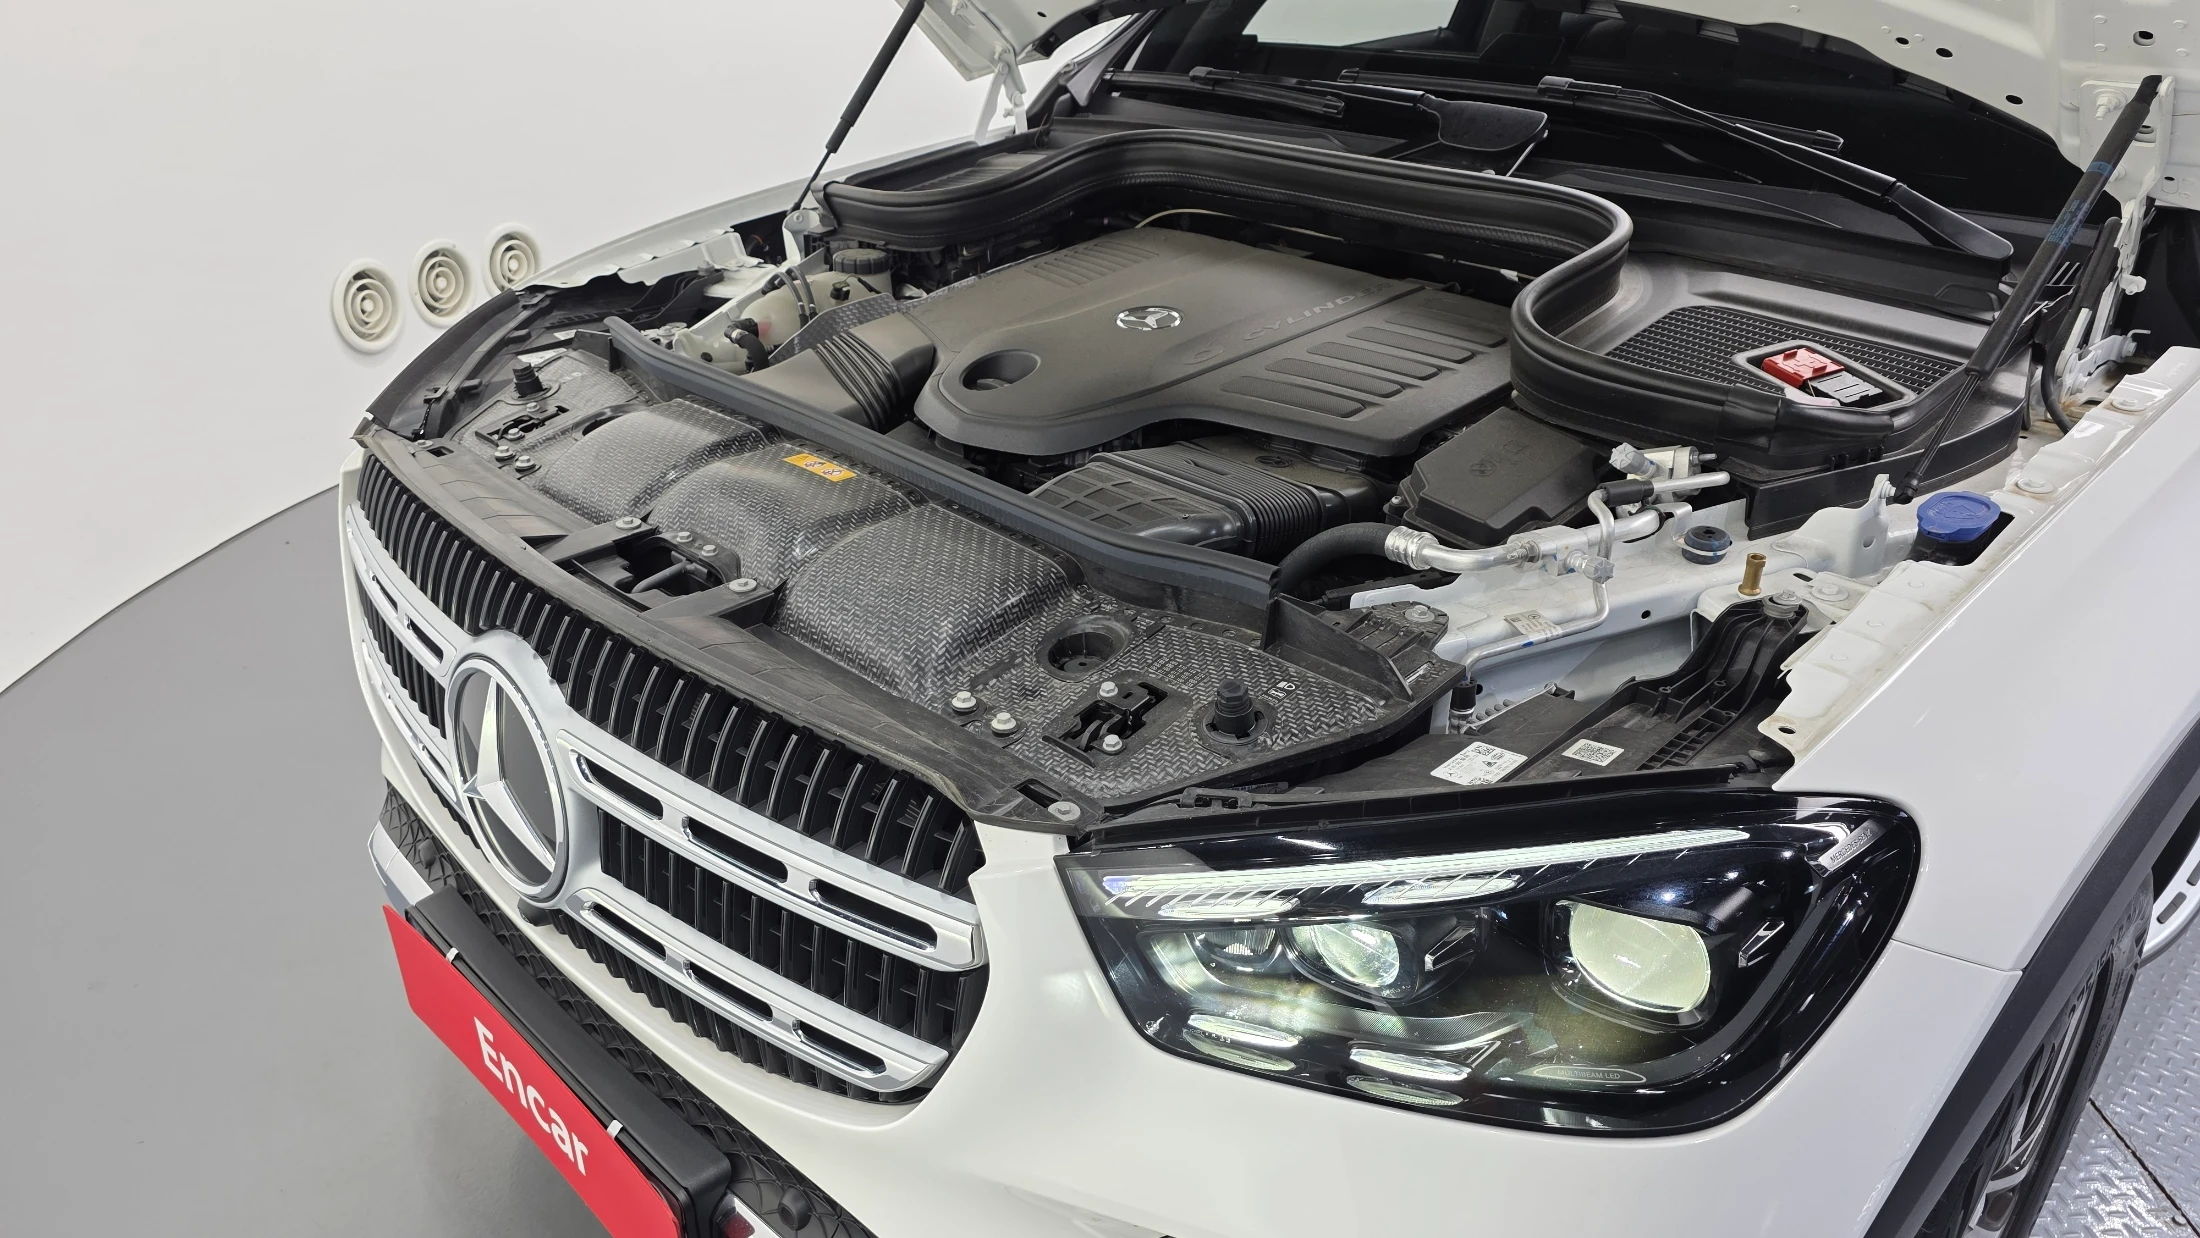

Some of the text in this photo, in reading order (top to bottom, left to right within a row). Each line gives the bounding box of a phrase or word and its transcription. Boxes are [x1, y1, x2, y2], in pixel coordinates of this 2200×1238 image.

[1242, 281, 1395, 341] CYLINDER
[473, 1015, 589, 1177] Encar
[1557, 1069, 1621, 1080] MULTIBEAM LED
